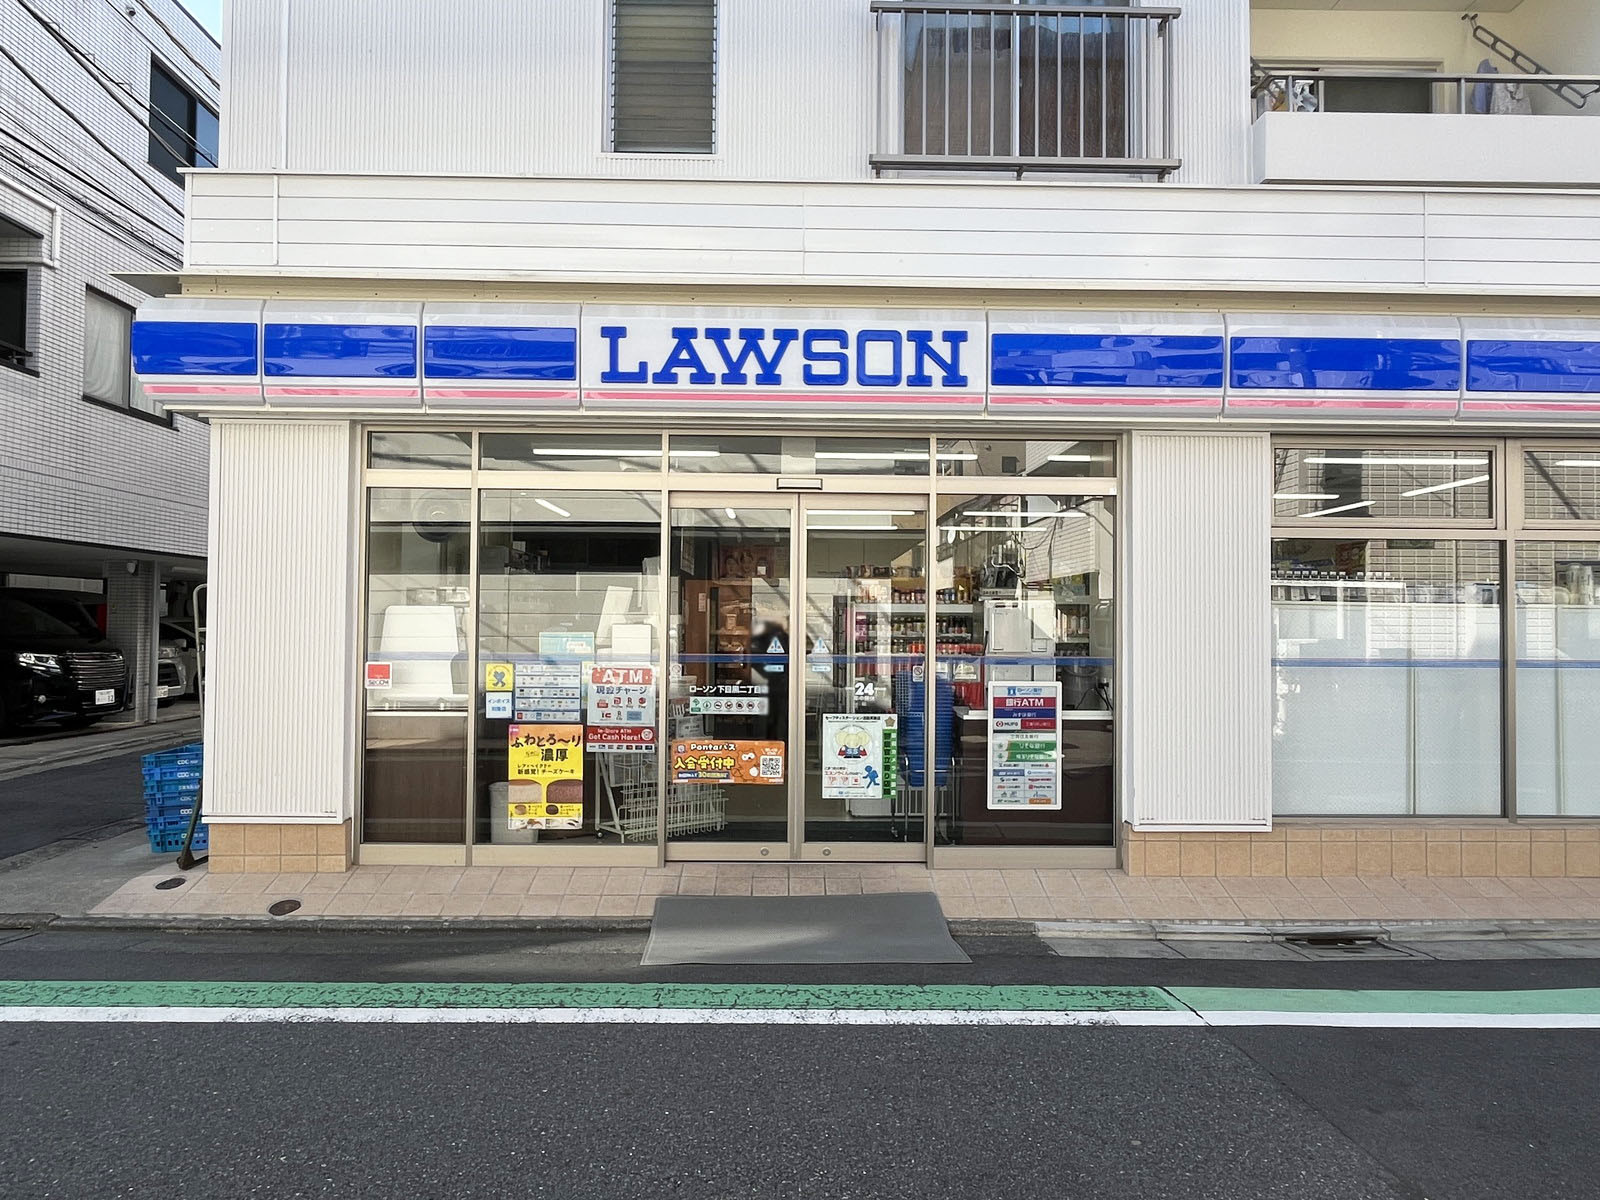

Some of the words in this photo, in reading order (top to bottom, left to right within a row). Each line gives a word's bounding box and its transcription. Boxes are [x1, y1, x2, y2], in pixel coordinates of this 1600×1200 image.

[600, 326, 968, 387] LAWSON
[602, 669, 644, 684] ATM
[855, 682, 875, 696] 24
[1005, 698, 1044, 707] 銀行ATM
[621, 733, 641, 741] Here!
[690, 743, 736, 752] Pontaパス
[541, 748, 568, 761] 濃厚
[674, 756, 735, 770] 入会受付中
